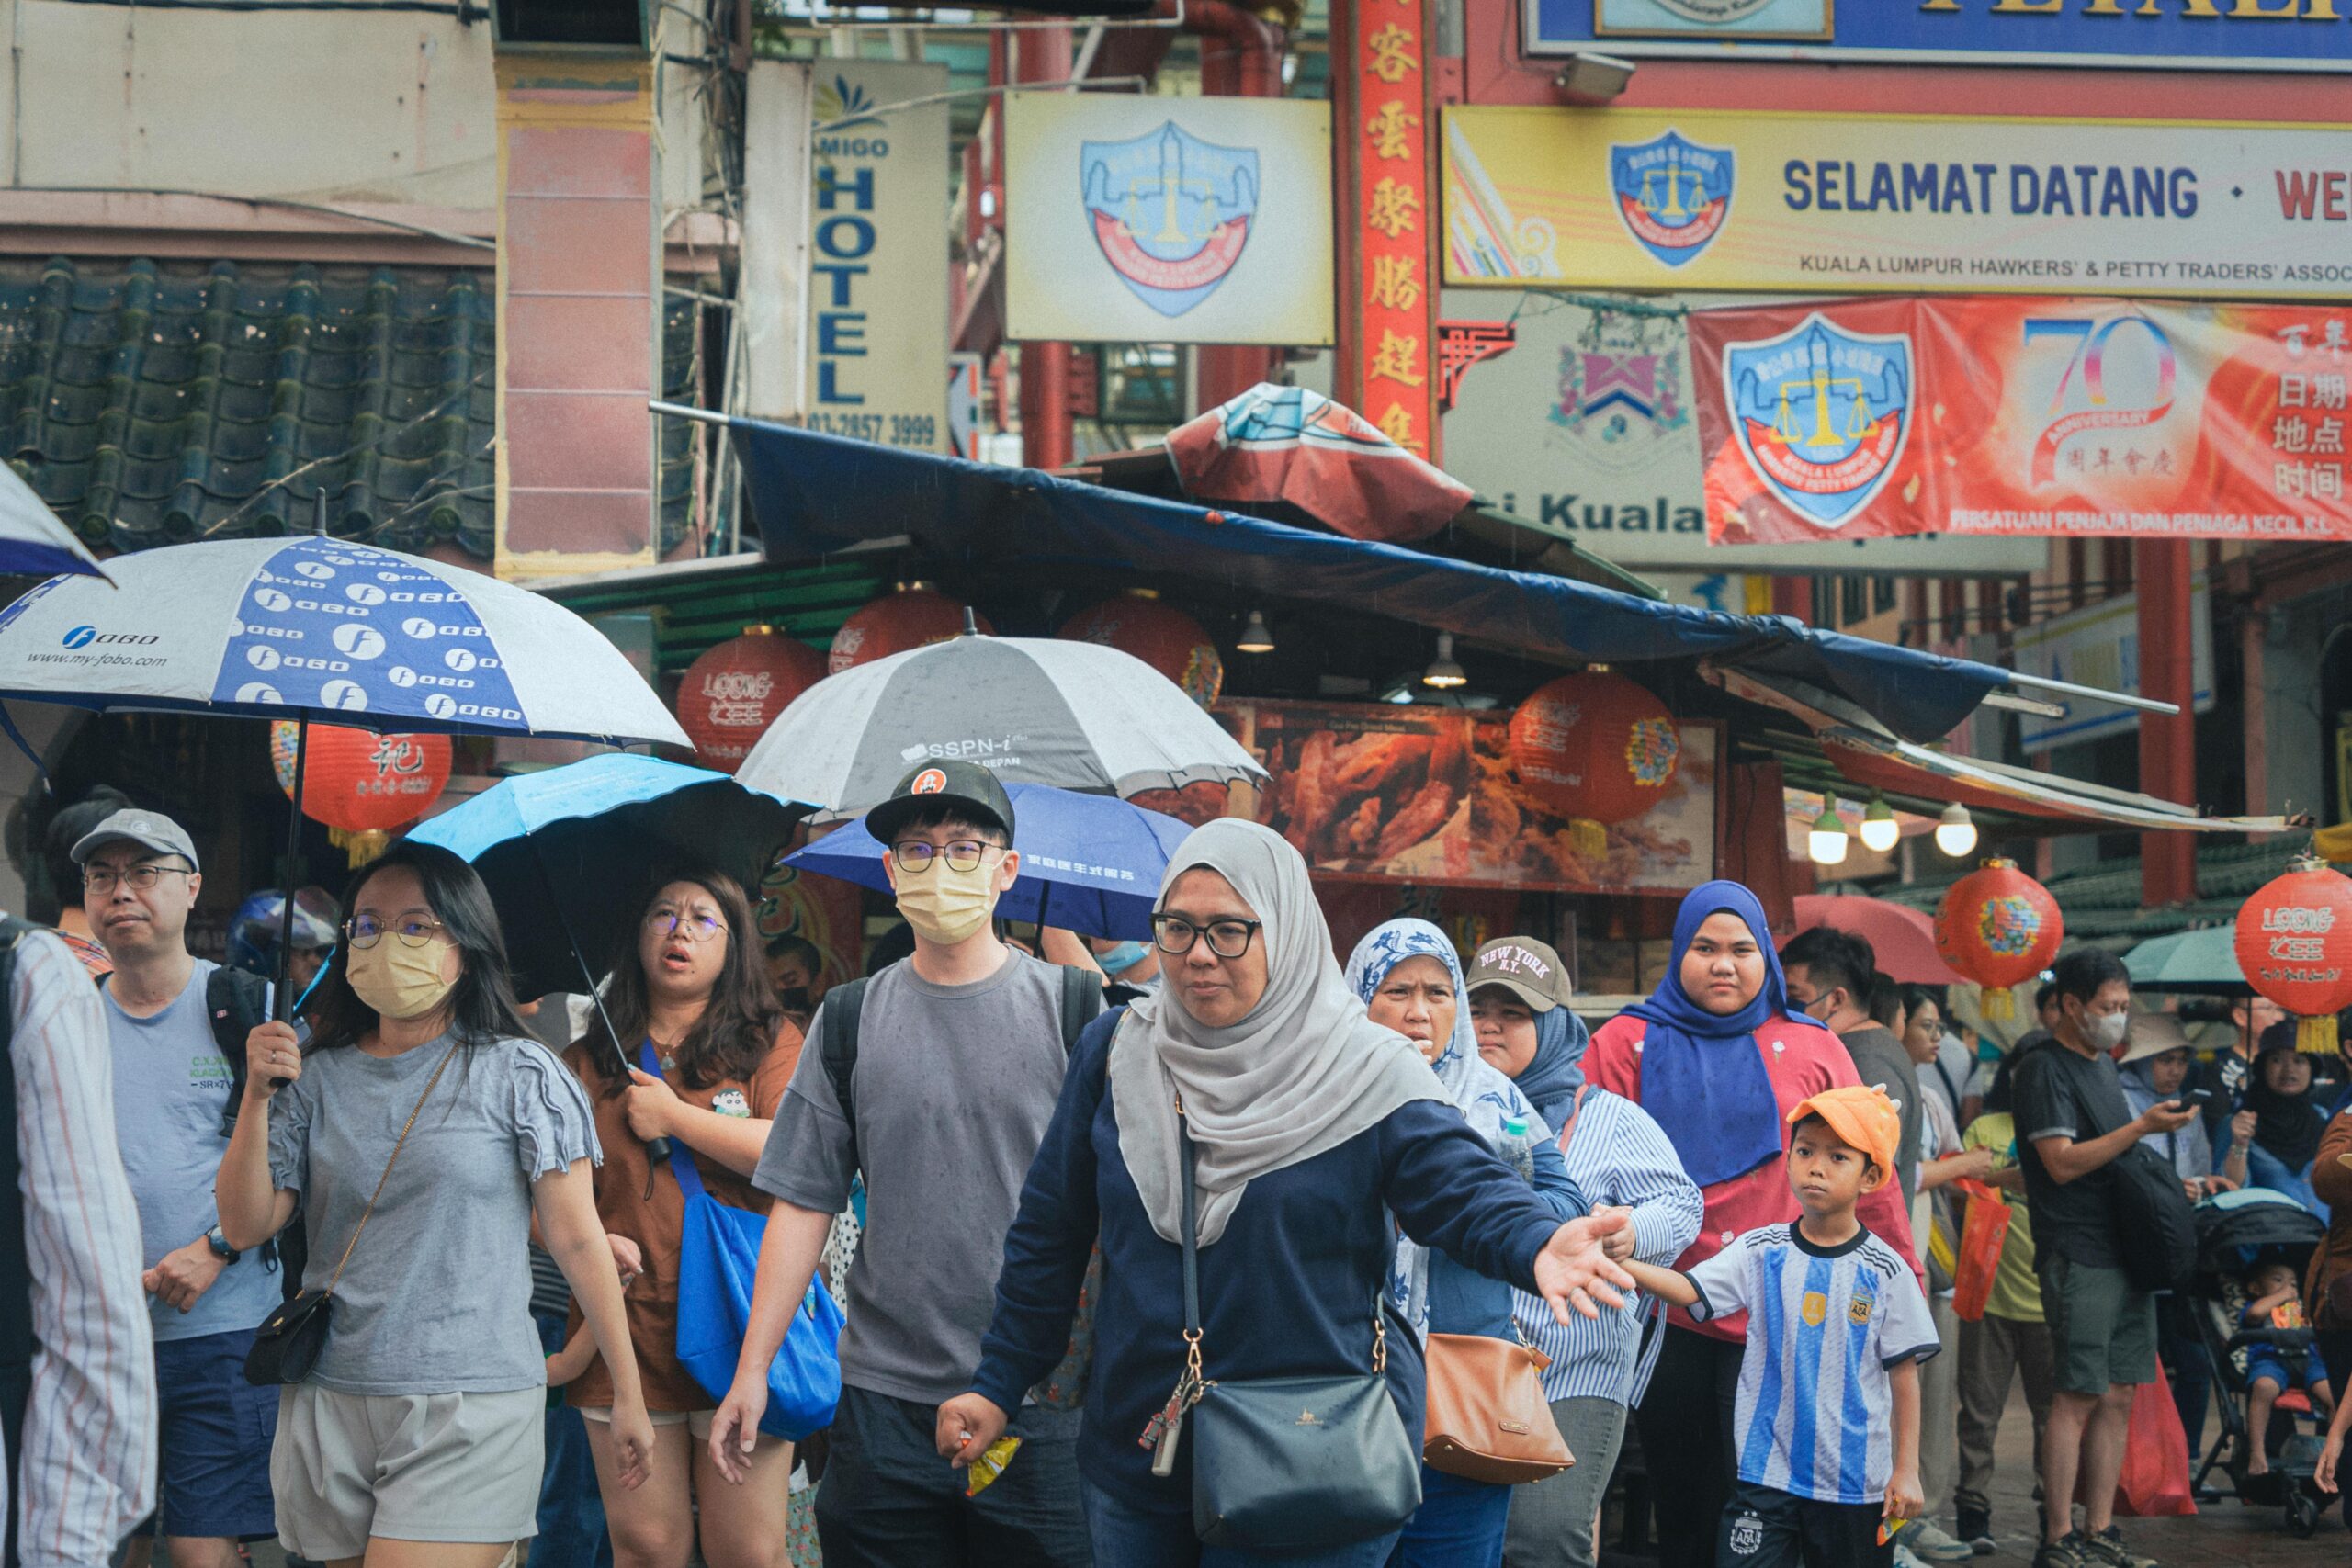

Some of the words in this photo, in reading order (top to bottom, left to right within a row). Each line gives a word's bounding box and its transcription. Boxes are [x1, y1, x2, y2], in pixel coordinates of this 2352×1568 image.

[1783, 159, 1997, 214] SELAMAT
[2010, 164, 2199, 219] DATANG
[2274, 169, 2352, 220] WE
[1800, 255, 1871, 273] KUALA
[1877, 257, 1963, 274] LUMPUR
[2085, 261, 2099, 276] &
[2106, 261, 2170, 278] PETTY
[813, 165, 876, 405] HOTEL
[2024, 316, 2177, 415] 70
[2278, 373, 2347, 410] 日期
[2046, 412, 2150, 446] ANNIVERSARY
[2272, 415, 2345, 453] 地点
[2274, 460, 2343, 501] 时间
[1541, 493, 1704, 533] Kuala
[1950, 509, 2052, 530] PERSATUAN
[2131, 513, 2169, 531] DAN
[2172, 513, 2249, 533] PENIAGA
[2253, 514, 2301, 535] KECIL
[27, 653, 168, 667] www.my-fobo.com
[702, 671, 774, 701] LOONG
[708, 699, 763, 727] KEE
[2261, 906, 2335, 933] LOONG
[1480, 945, 1513, 967] NEW
[1515, 946, 1550, 979] YORK
[2268, 937, 2324, 961] KEE
[1498, 959, 1521, 974] N.Y.
[1850, 1302, 1868, 1317] AFA
[1736, 1528, 1755, 1546] AFA
